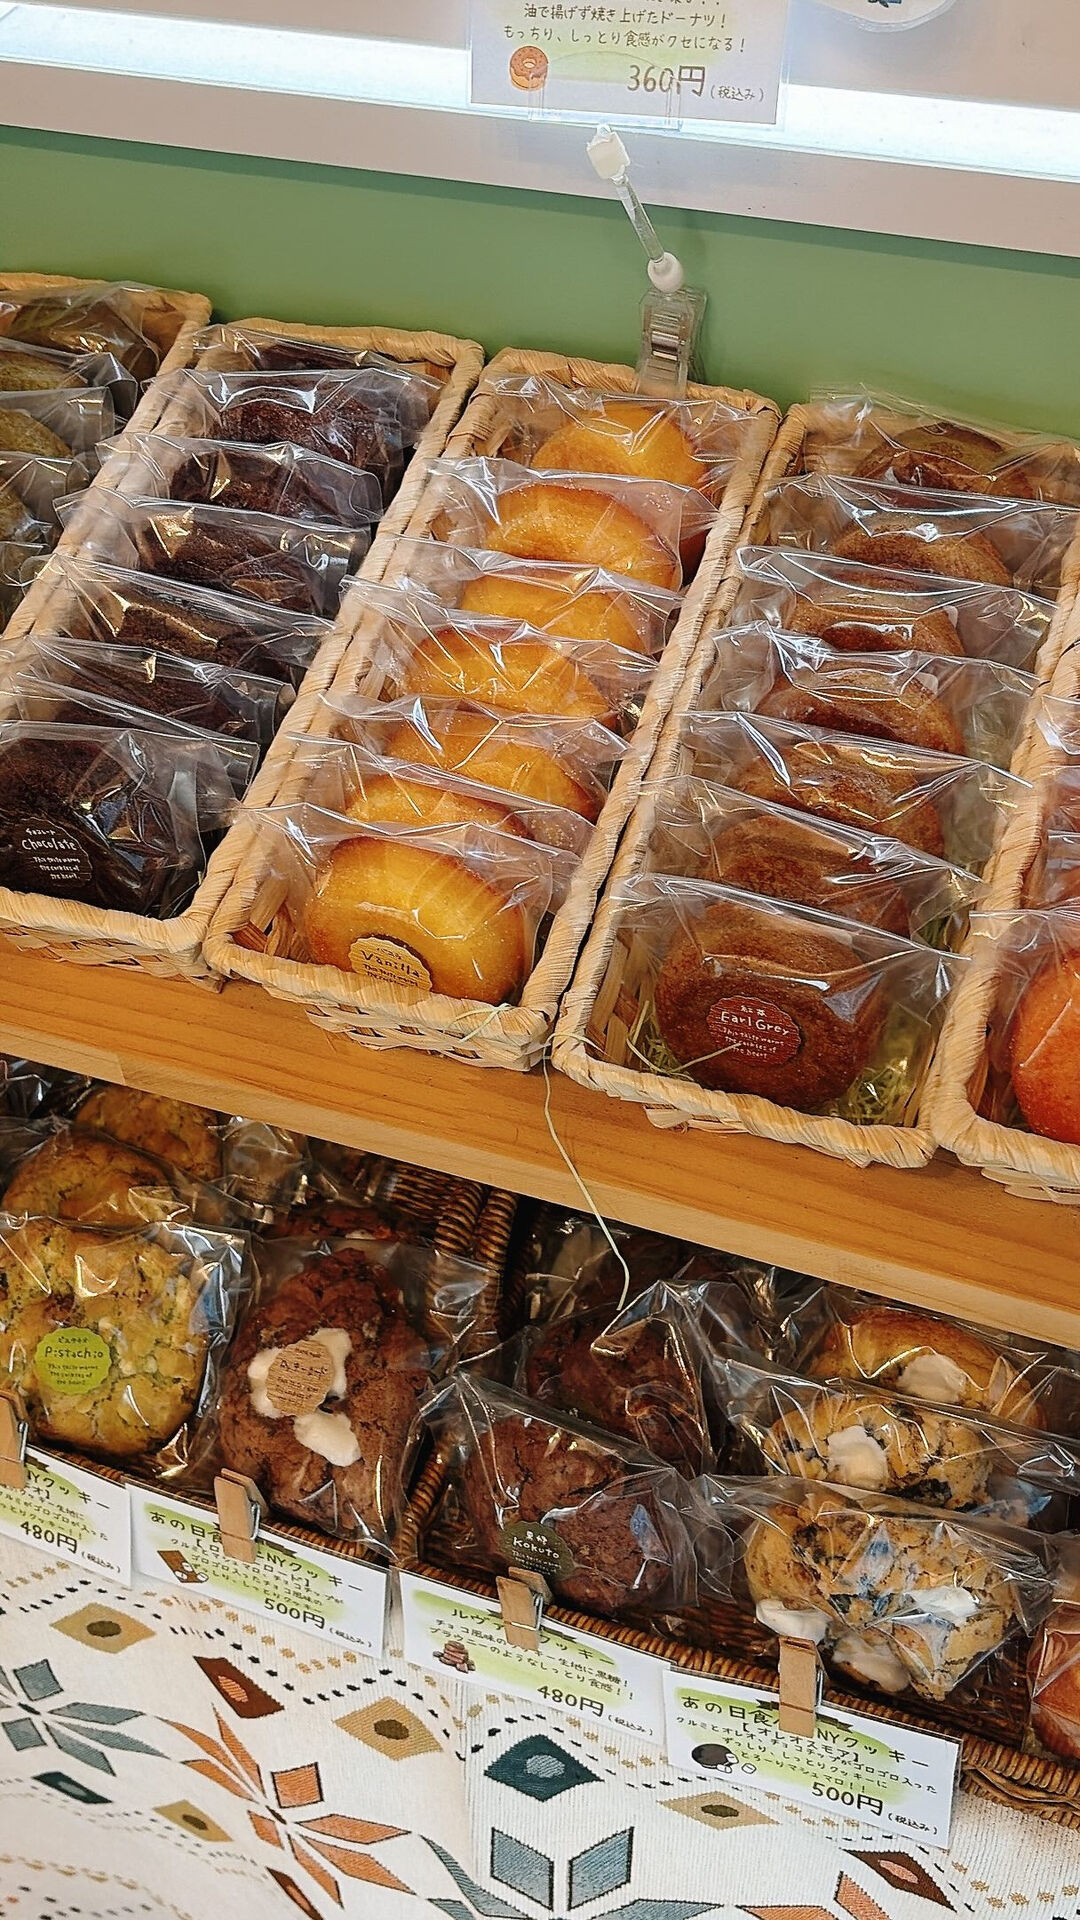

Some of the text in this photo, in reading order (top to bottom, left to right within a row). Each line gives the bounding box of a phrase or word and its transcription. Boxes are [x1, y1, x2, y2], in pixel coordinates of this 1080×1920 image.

[524, 3, 726, 28] 油で揚げず焼き上げたドーナツ!
[504, 25, 745, 53] もっちり、しっとり食感がクセになる!
[627, 64, 706, 97] 360円
[22, 838, 78, 850] Chocolate
[361, 950, 420, 978] Vanilla
[721, 1011, 790, 1036] Earl Grey
[45, 1346, 104, 1359] Pistachio
[20, 1521, 78, 1554] 480円
[513, 1536, 560, 1559] Kokuto
[264, 1598, 326, 1629] 500円
[537, 1685, 604, 1717] 480円
[681, 1695, 929, 1767] あの日食NYクッキー
[811, 1782, 883, 1816] 500円
